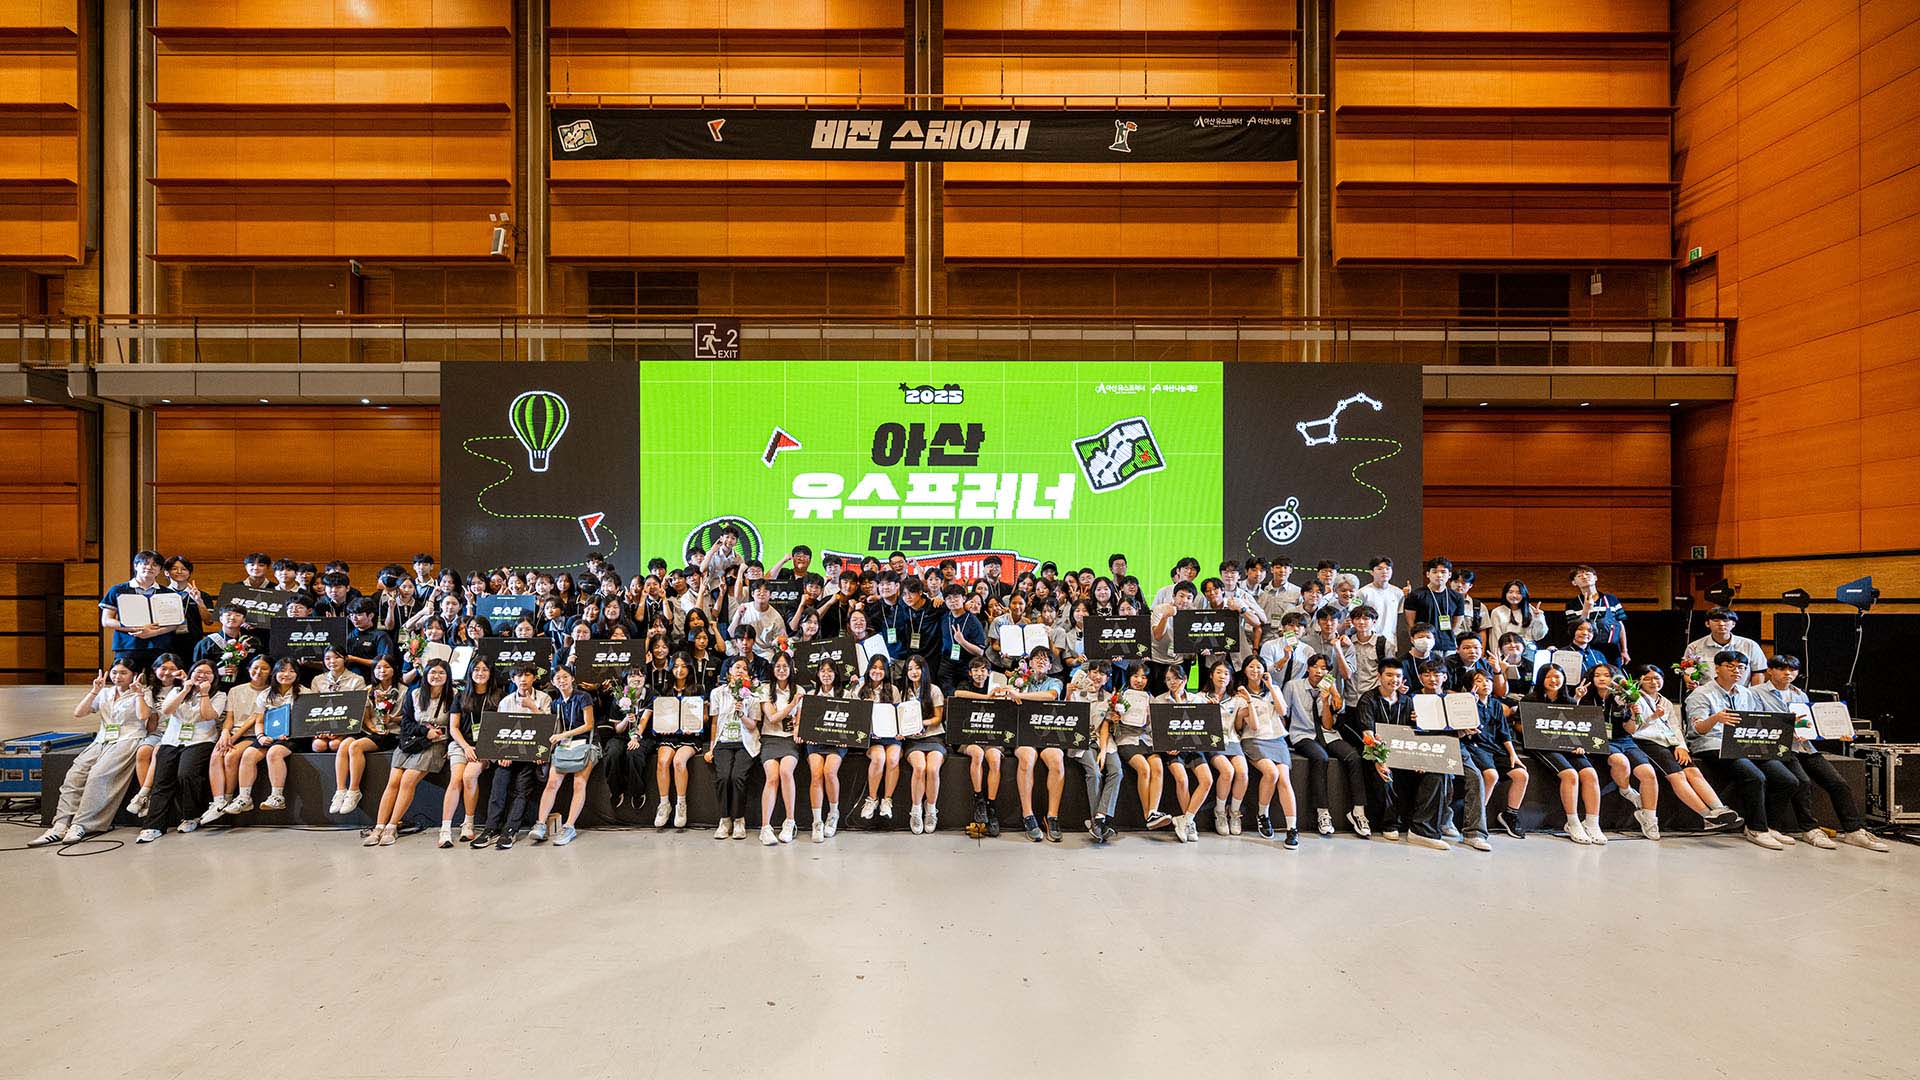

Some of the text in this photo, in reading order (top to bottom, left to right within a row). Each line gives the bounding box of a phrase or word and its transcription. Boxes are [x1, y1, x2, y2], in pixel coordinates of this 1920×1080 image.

[811, 119, 1031, 151] 비전 스테이지
[726, 329, 738, 348] 2
[717, 350, 738, 359] EXIT
[904, 389, 964, 404] 2025
[870, 422, 986, 467] 아산
[787, 472, 1076, 520] 유스프러너
[868, 525, 994, 551] 데모데이
[770, 591, 799, 600] 우수상
[491, 606, 523, 616] 우수상
[1190, 622, 1225, 632] 우수상
[289, 631, 329, 642] 우수상
[1101, 628, 1137, 639] 우수상
[497, 651, 536, 661] 우수상
[594, 652, 631, 663] 우수상
[808, 649, 843, 663] 우수상
[308, 705, 348, 717] 우수상
[822, 710, 850, 723] 대상
[970, 711, 996, 723] 대상
[1029, 713, 1079, 727] 최우수상
[1168, 719, 1206, 730] 우수상
[1535, 718, 1592, 732] 최우수상
[496, 728, 537, 740] 우수상
[1733, 726, 1783, 740] 최우수상
[1390, 739, 1447, 754] 최우수상
